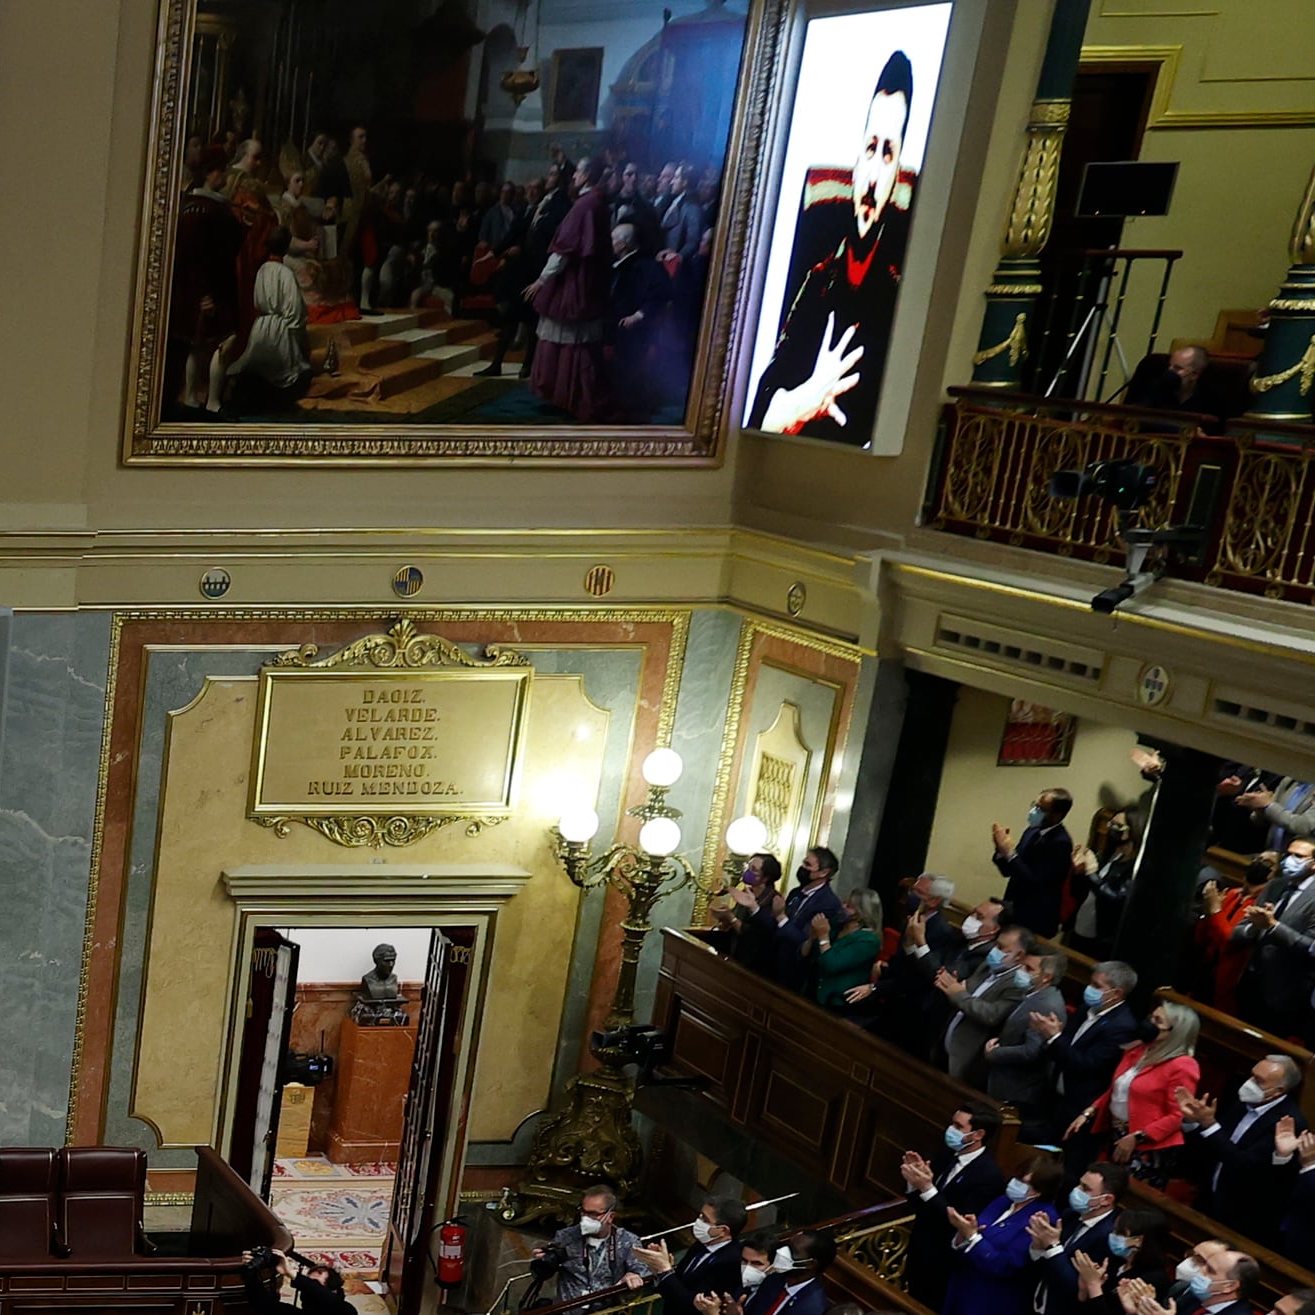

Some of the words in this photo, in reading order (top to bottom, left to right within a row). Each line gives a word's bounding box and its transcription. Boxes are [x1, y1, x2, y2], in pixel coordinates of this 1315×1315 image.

[362, 689, 427, 704] DAOIZ.
[345, 708, 441, 723] VELARDE.
[340, 727, 439, 741] ALVAREZ.
[339, 745, 438, 760] PALAFOX.
[343, 764, 430, 778] MORENO.
[307, 782, 354, 796] RUIZ
[361, 781, 464, 796] MENDOZA.
